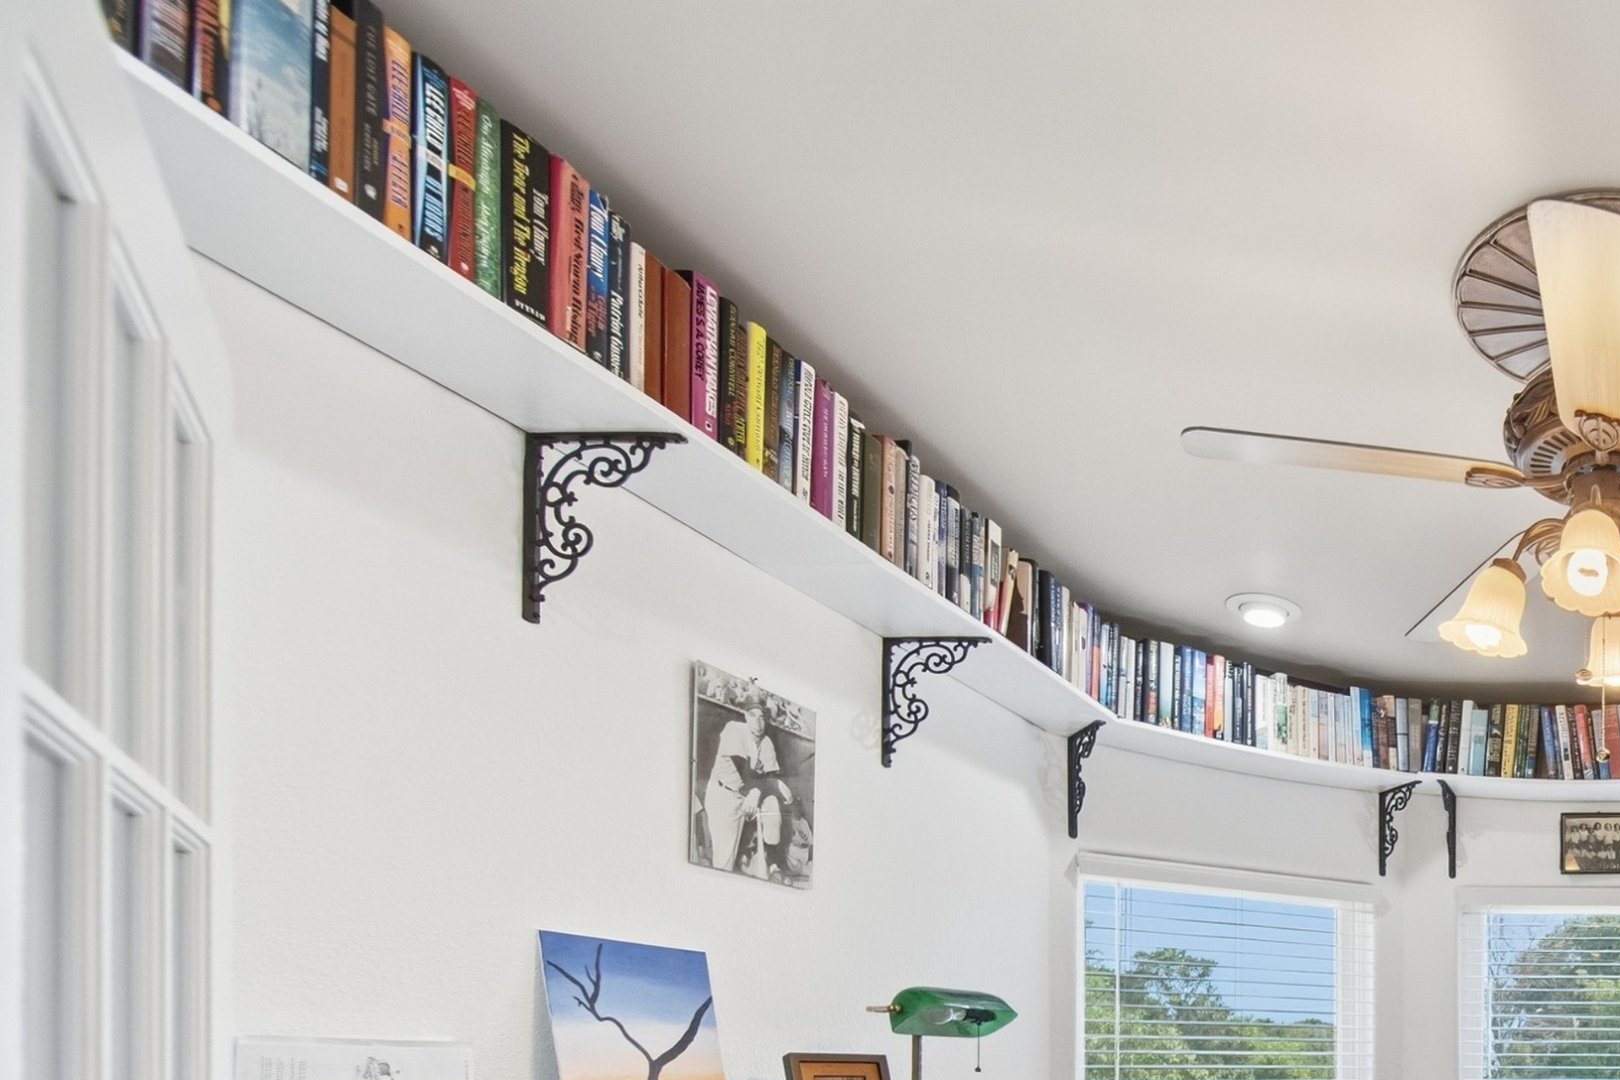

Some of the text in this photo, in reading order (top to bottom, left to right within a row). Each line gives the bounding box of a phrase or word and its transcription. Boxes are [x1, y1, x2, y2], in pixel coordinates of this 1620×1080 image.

[425, 82, 443, 113] LEE
[425, 110, 444, 152] CHILD
[424, 192, 443, 241] HOURS
[510, 132, 531, 295] The Bear and The Dragon
[529, 188, 549, 265] Tom Clancy
[588, 203, 609, 281] Tom Clancy
[572, 248, 584, 296] Storm
[567, 296, 583, 345] Rising
[610, 289, 624, 337] Patriot
[695, 279, 706, 318] JAMES
[694, 342, 706, 382] COREY
[704, 285, 718, 421] LEVIATHAN WAKES
